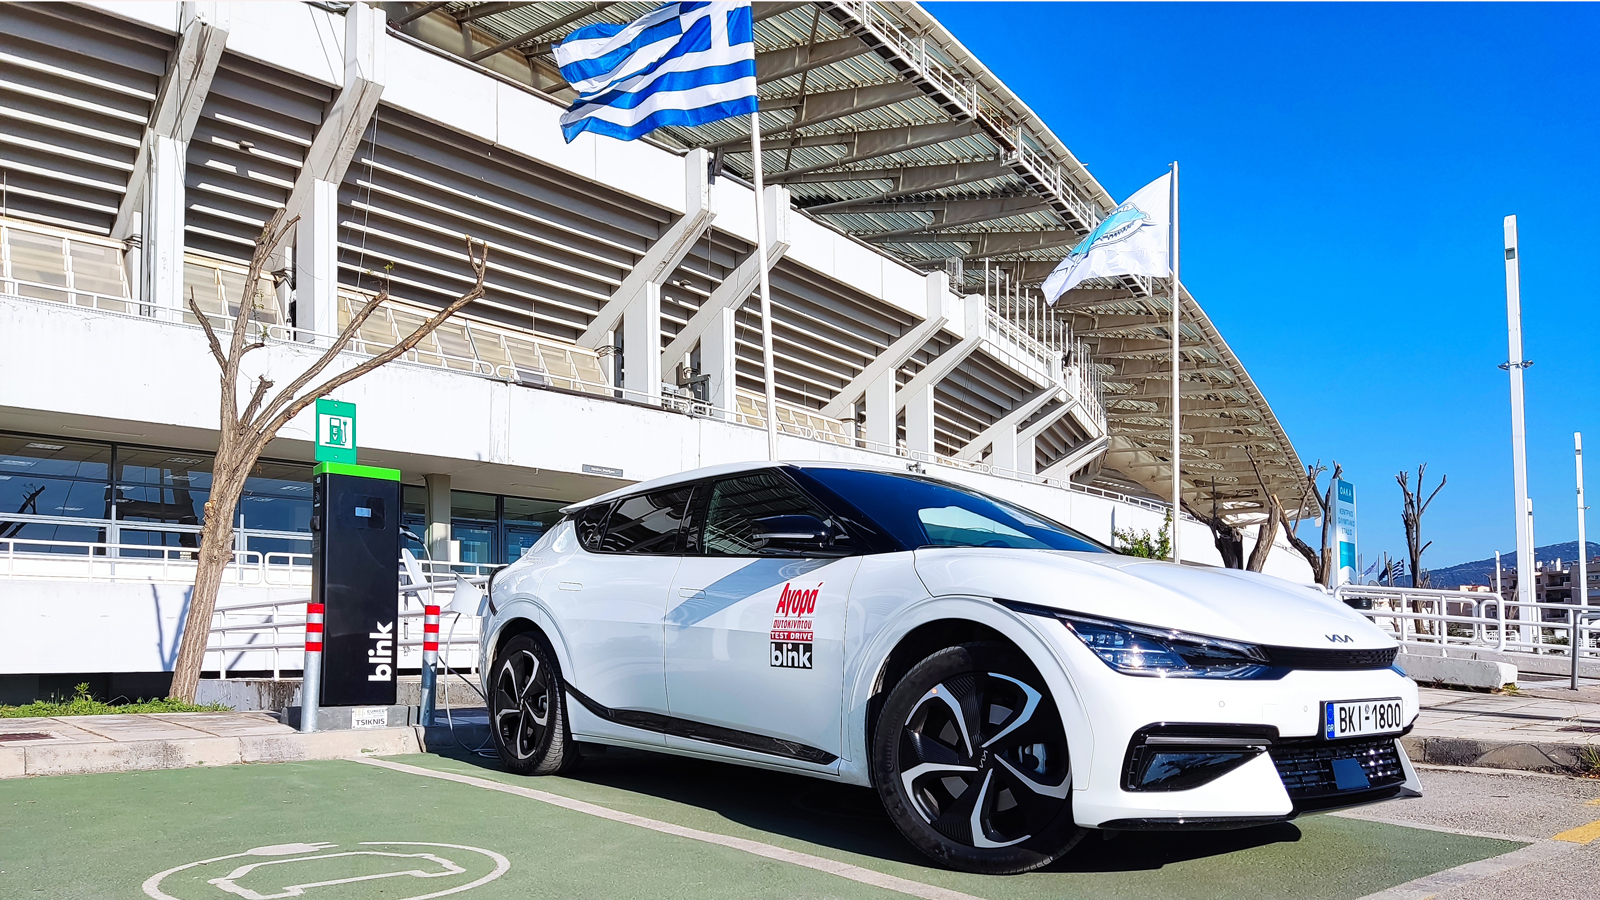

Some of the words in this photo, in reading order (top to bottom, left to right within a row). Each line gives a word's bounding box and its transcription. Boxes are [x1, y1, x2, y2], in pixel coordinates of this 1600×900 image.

[771, 632, 788, 640] TEST
[790, 632, 813, 641] DRIVE
[368, 621, 393, 681] blink
[771, 643, 812, 668] blink
[355, 718, 386, 726] TSIKNIS
